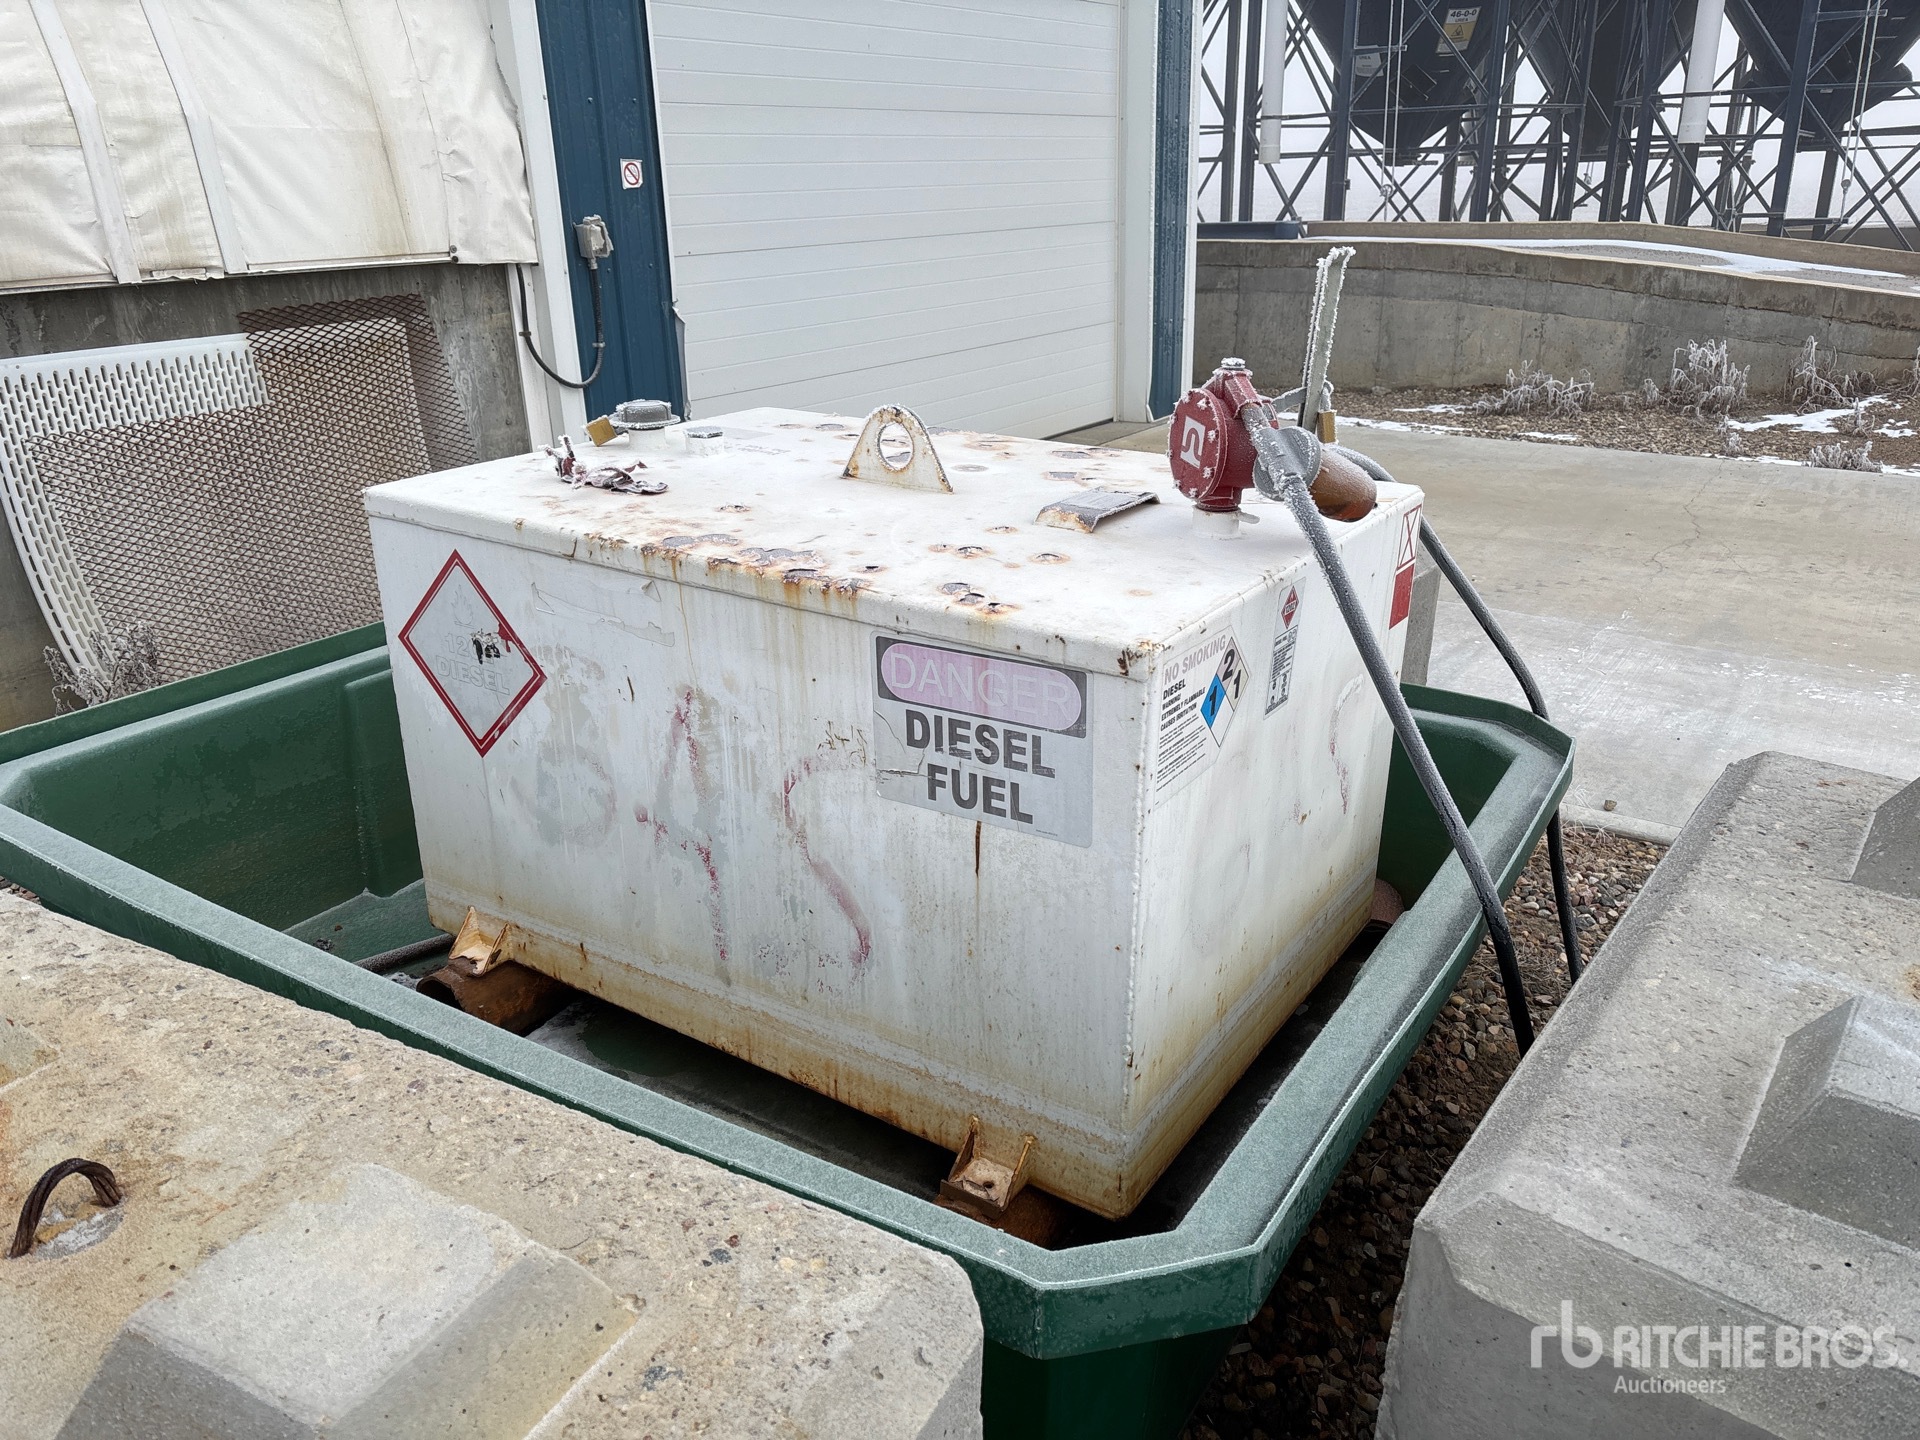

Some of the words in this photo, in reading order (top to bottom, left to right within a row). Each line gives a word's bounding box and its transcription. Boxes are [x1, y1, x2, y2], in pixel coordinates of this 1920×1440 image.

[1450, 8, 1477, 18] 46-0-0
[435, 654, 511, 696] DIESEL
[1164, 662, 1179, 685] NO
[1181, 634, 1226, 674] SMOKING
[1222, 648, 1235, 682] 2
[890, 652, 1073, 725] DANGER
[1163, 678, 1186, 700] DIESEL
[1209, 685, 1218, 717] 1
[1233, 669, 1241, 700] 1
[905, 709, 1056, 779] DIESEL
[927, 763, 1034, 825] FUEL
